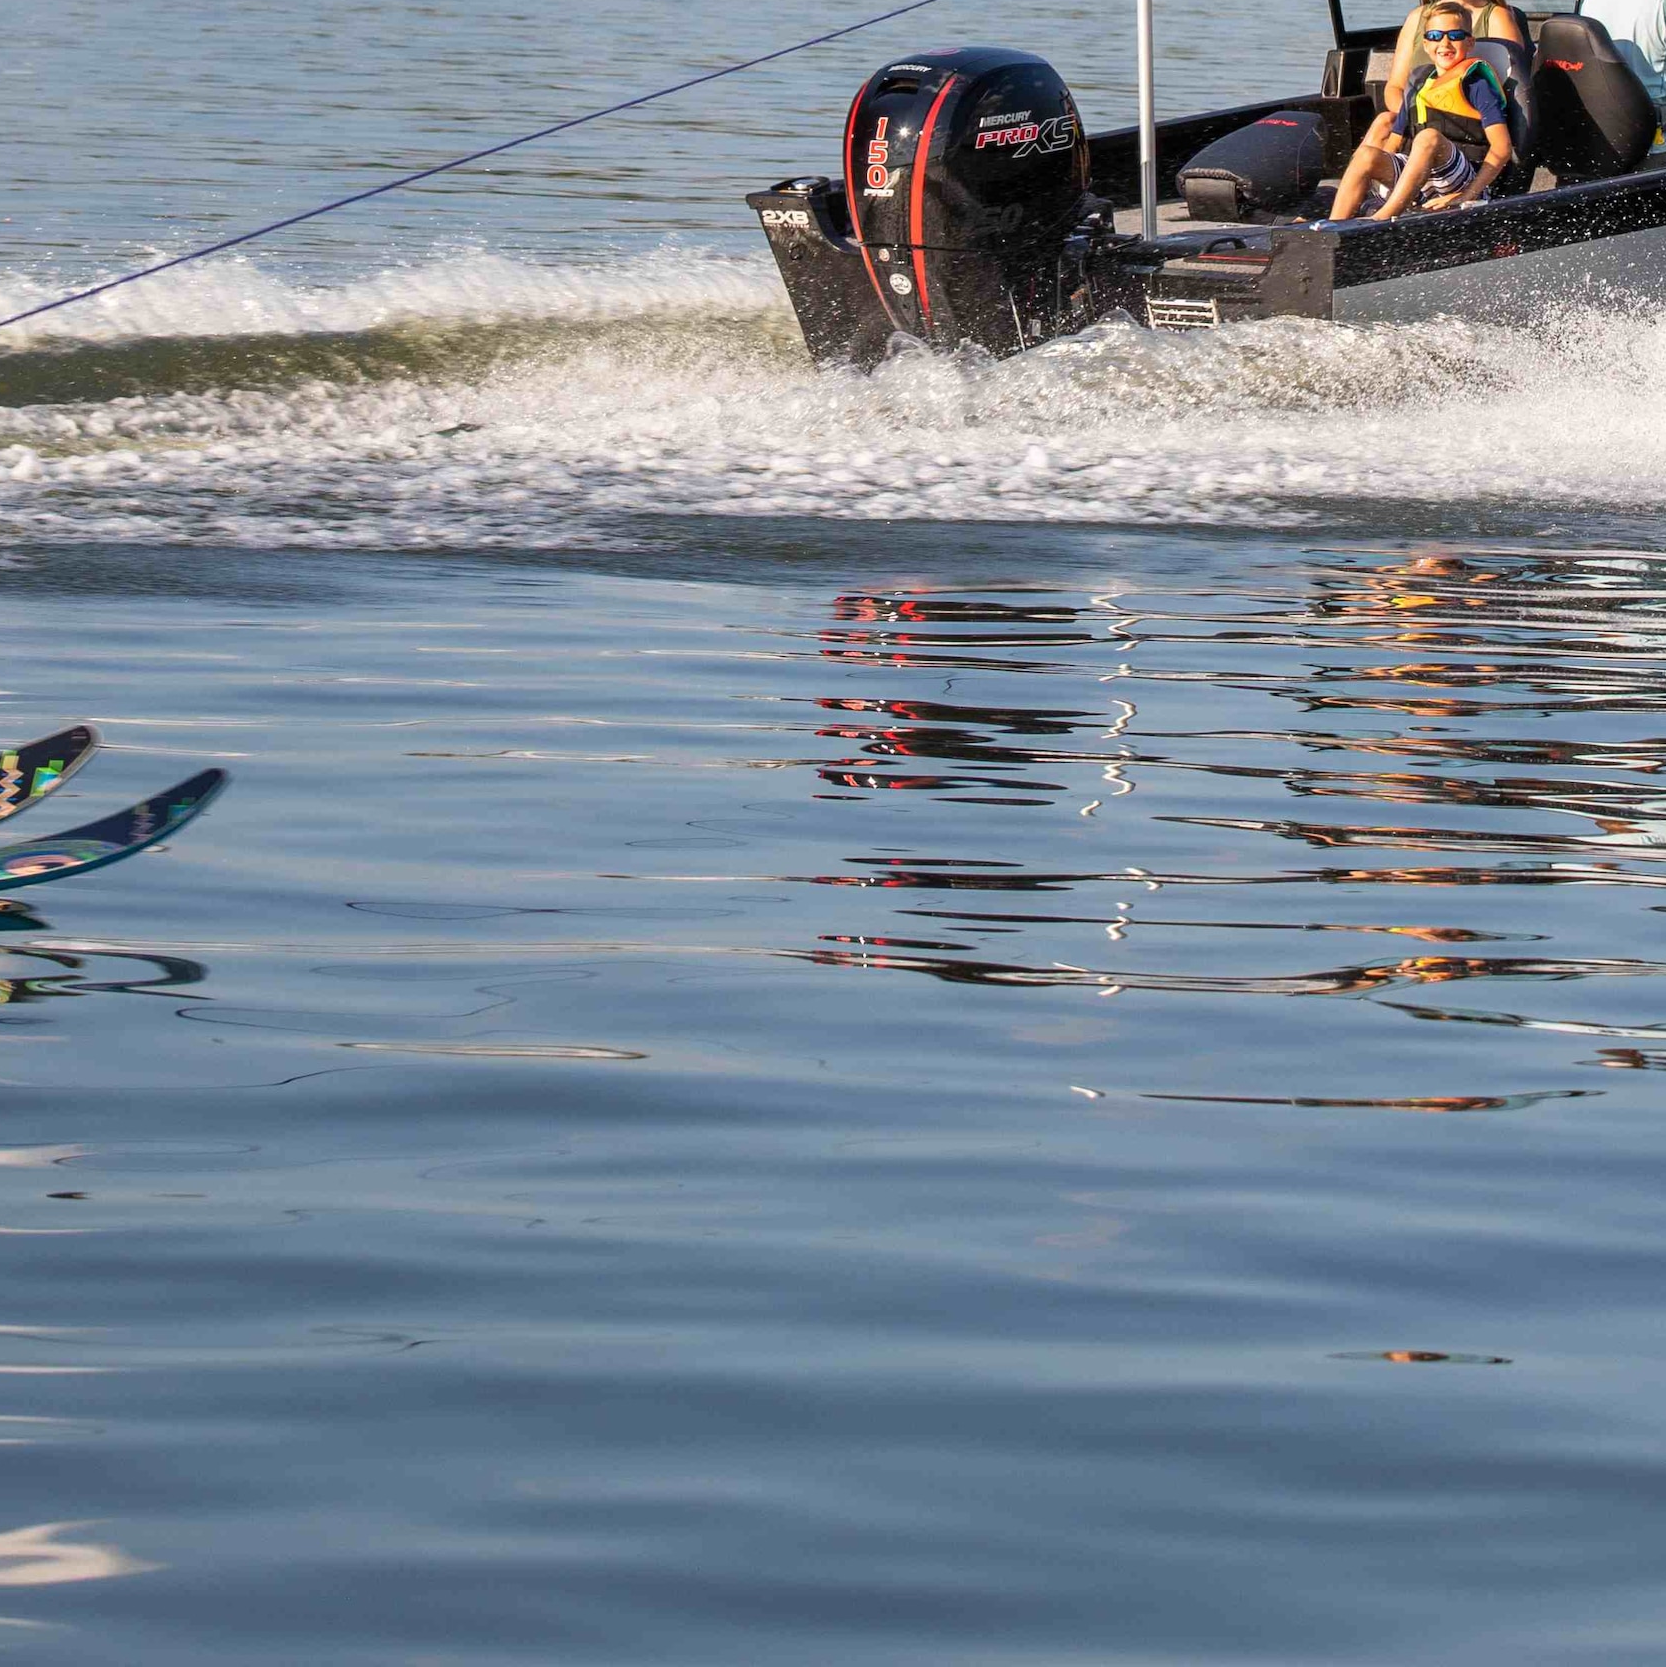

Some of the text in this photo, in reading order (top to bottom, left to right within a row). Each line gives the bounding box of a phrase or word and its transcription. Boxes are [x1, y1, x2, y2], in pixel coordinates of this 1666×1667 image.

[887, 64, 932, 72] MERCURY
[979, 110, 1032, 128] MERCURY
[975, 124, 1039, 149] PRO
[866, 116, 889, 188] 150
[863, 188, 894, 197] PRO
[761, 210, 809, 224] 2XB
